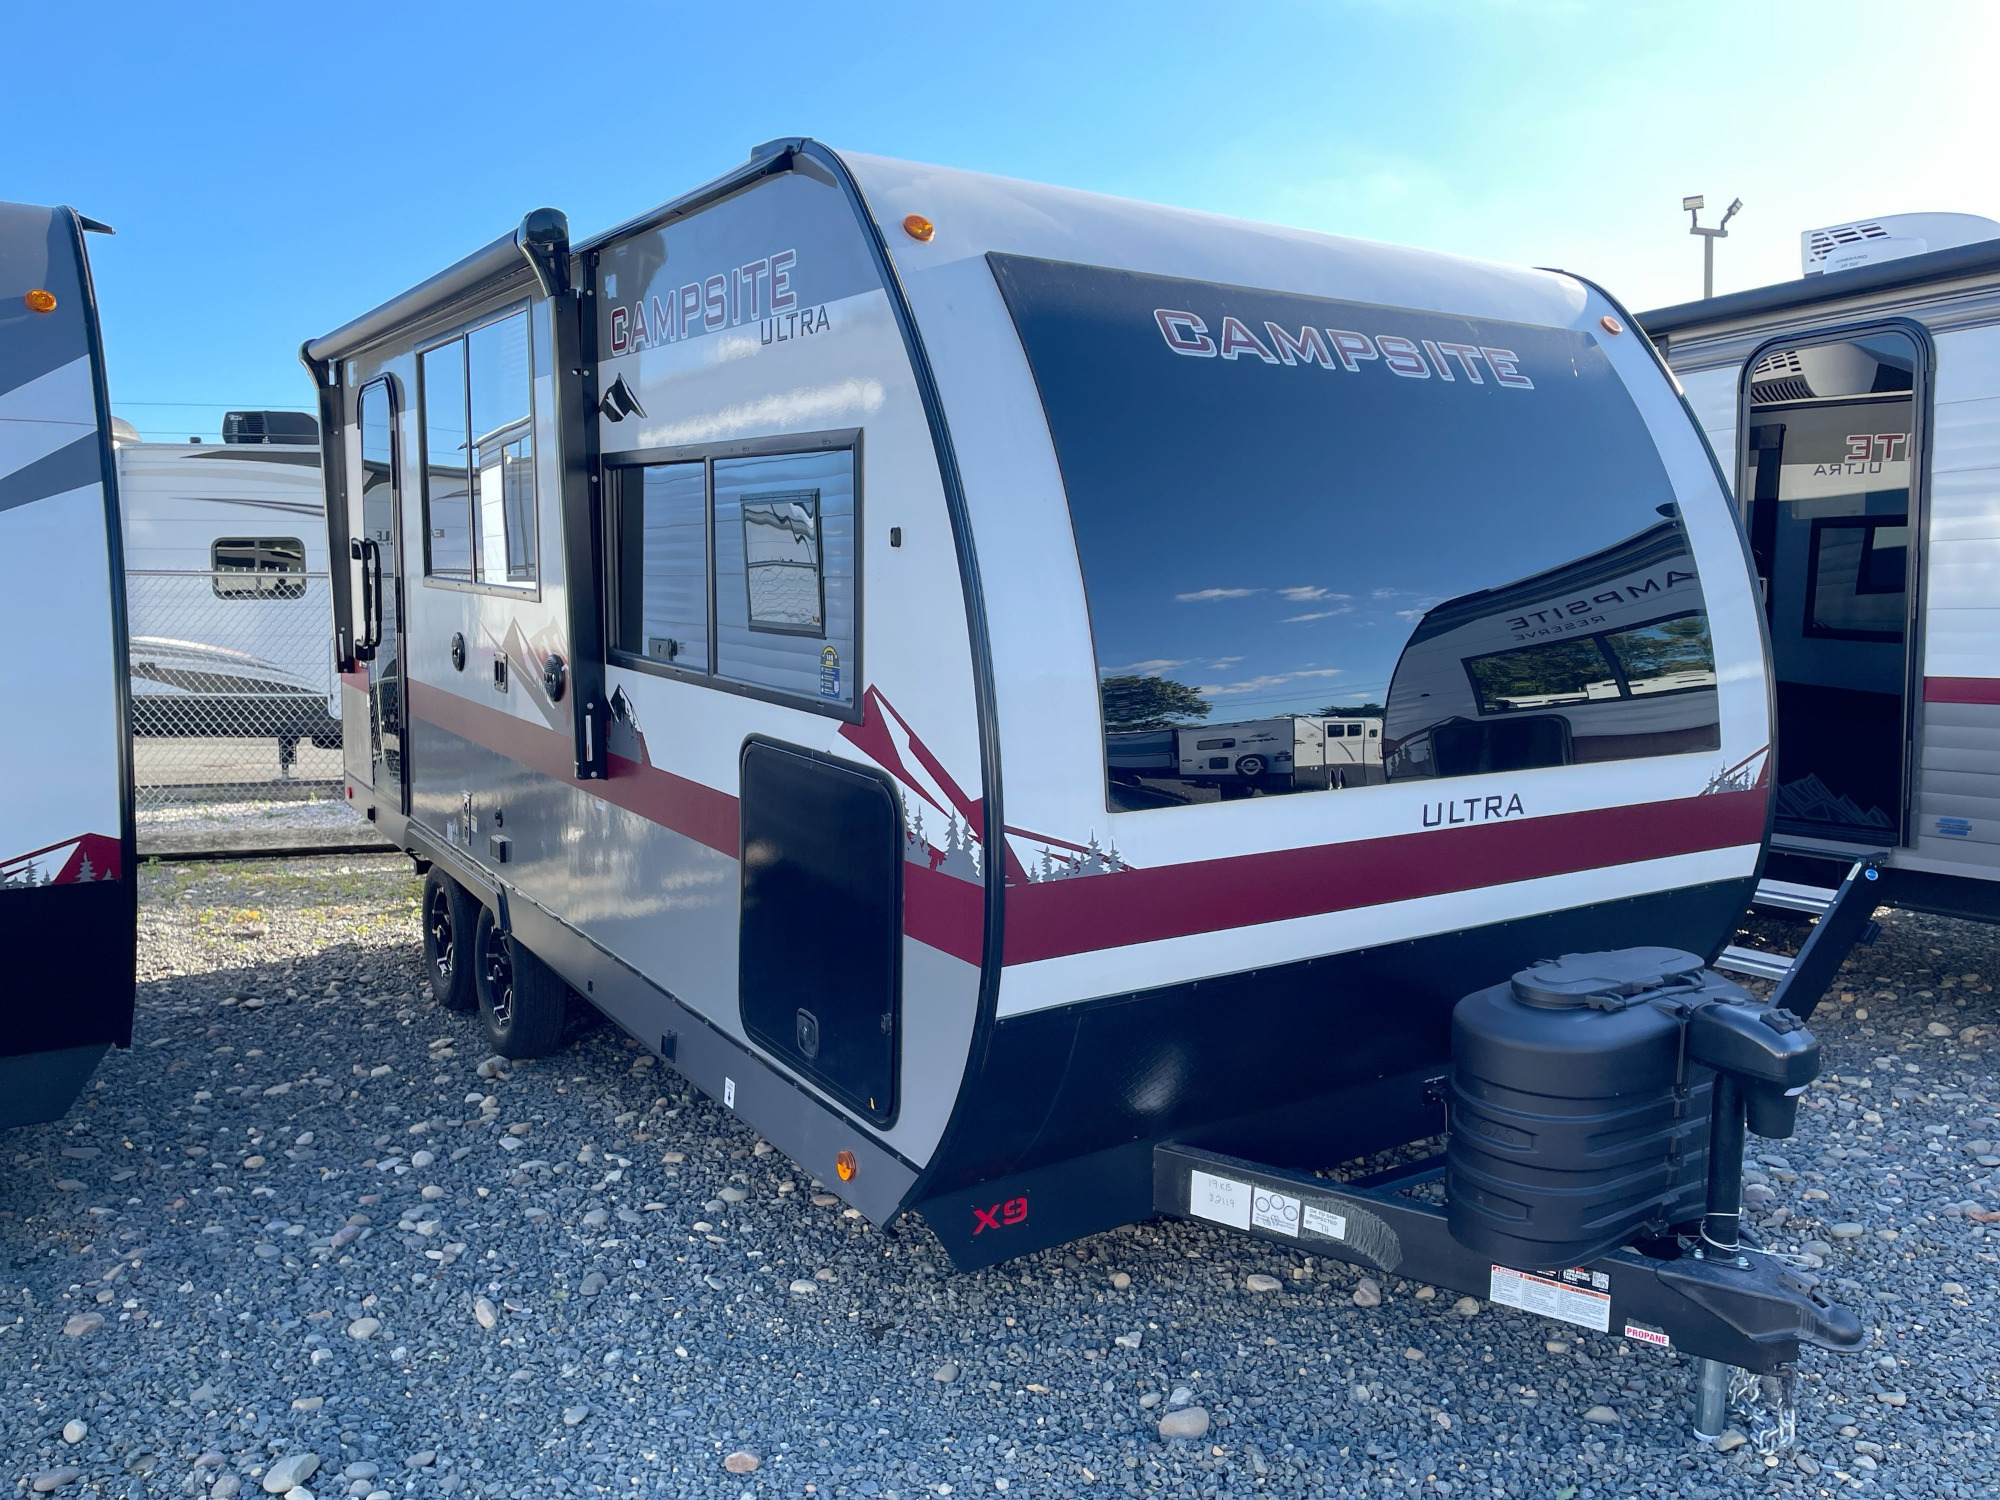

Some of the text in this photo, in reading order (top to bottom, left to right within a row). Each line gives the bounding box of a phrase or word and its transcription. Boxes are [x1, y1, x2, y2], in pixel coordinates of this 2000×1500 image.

[610, 249, 796, 357] CAMPSITE
[760, 305, 830, 345] ULTRA
[1153, 309, 1535, 390] CAMPSITE
[1423, 793, 1524, 827] ULTRA
[1480, 1121, 1514, 1144] GAS
[973, 1197, 1028, 1236] X9
[1532, 1277, 1555, 1286] WARNING
[1574, 1288, 1599, 1298] WARNING
[1626, 1327, 1667, 1344] PROPANE
